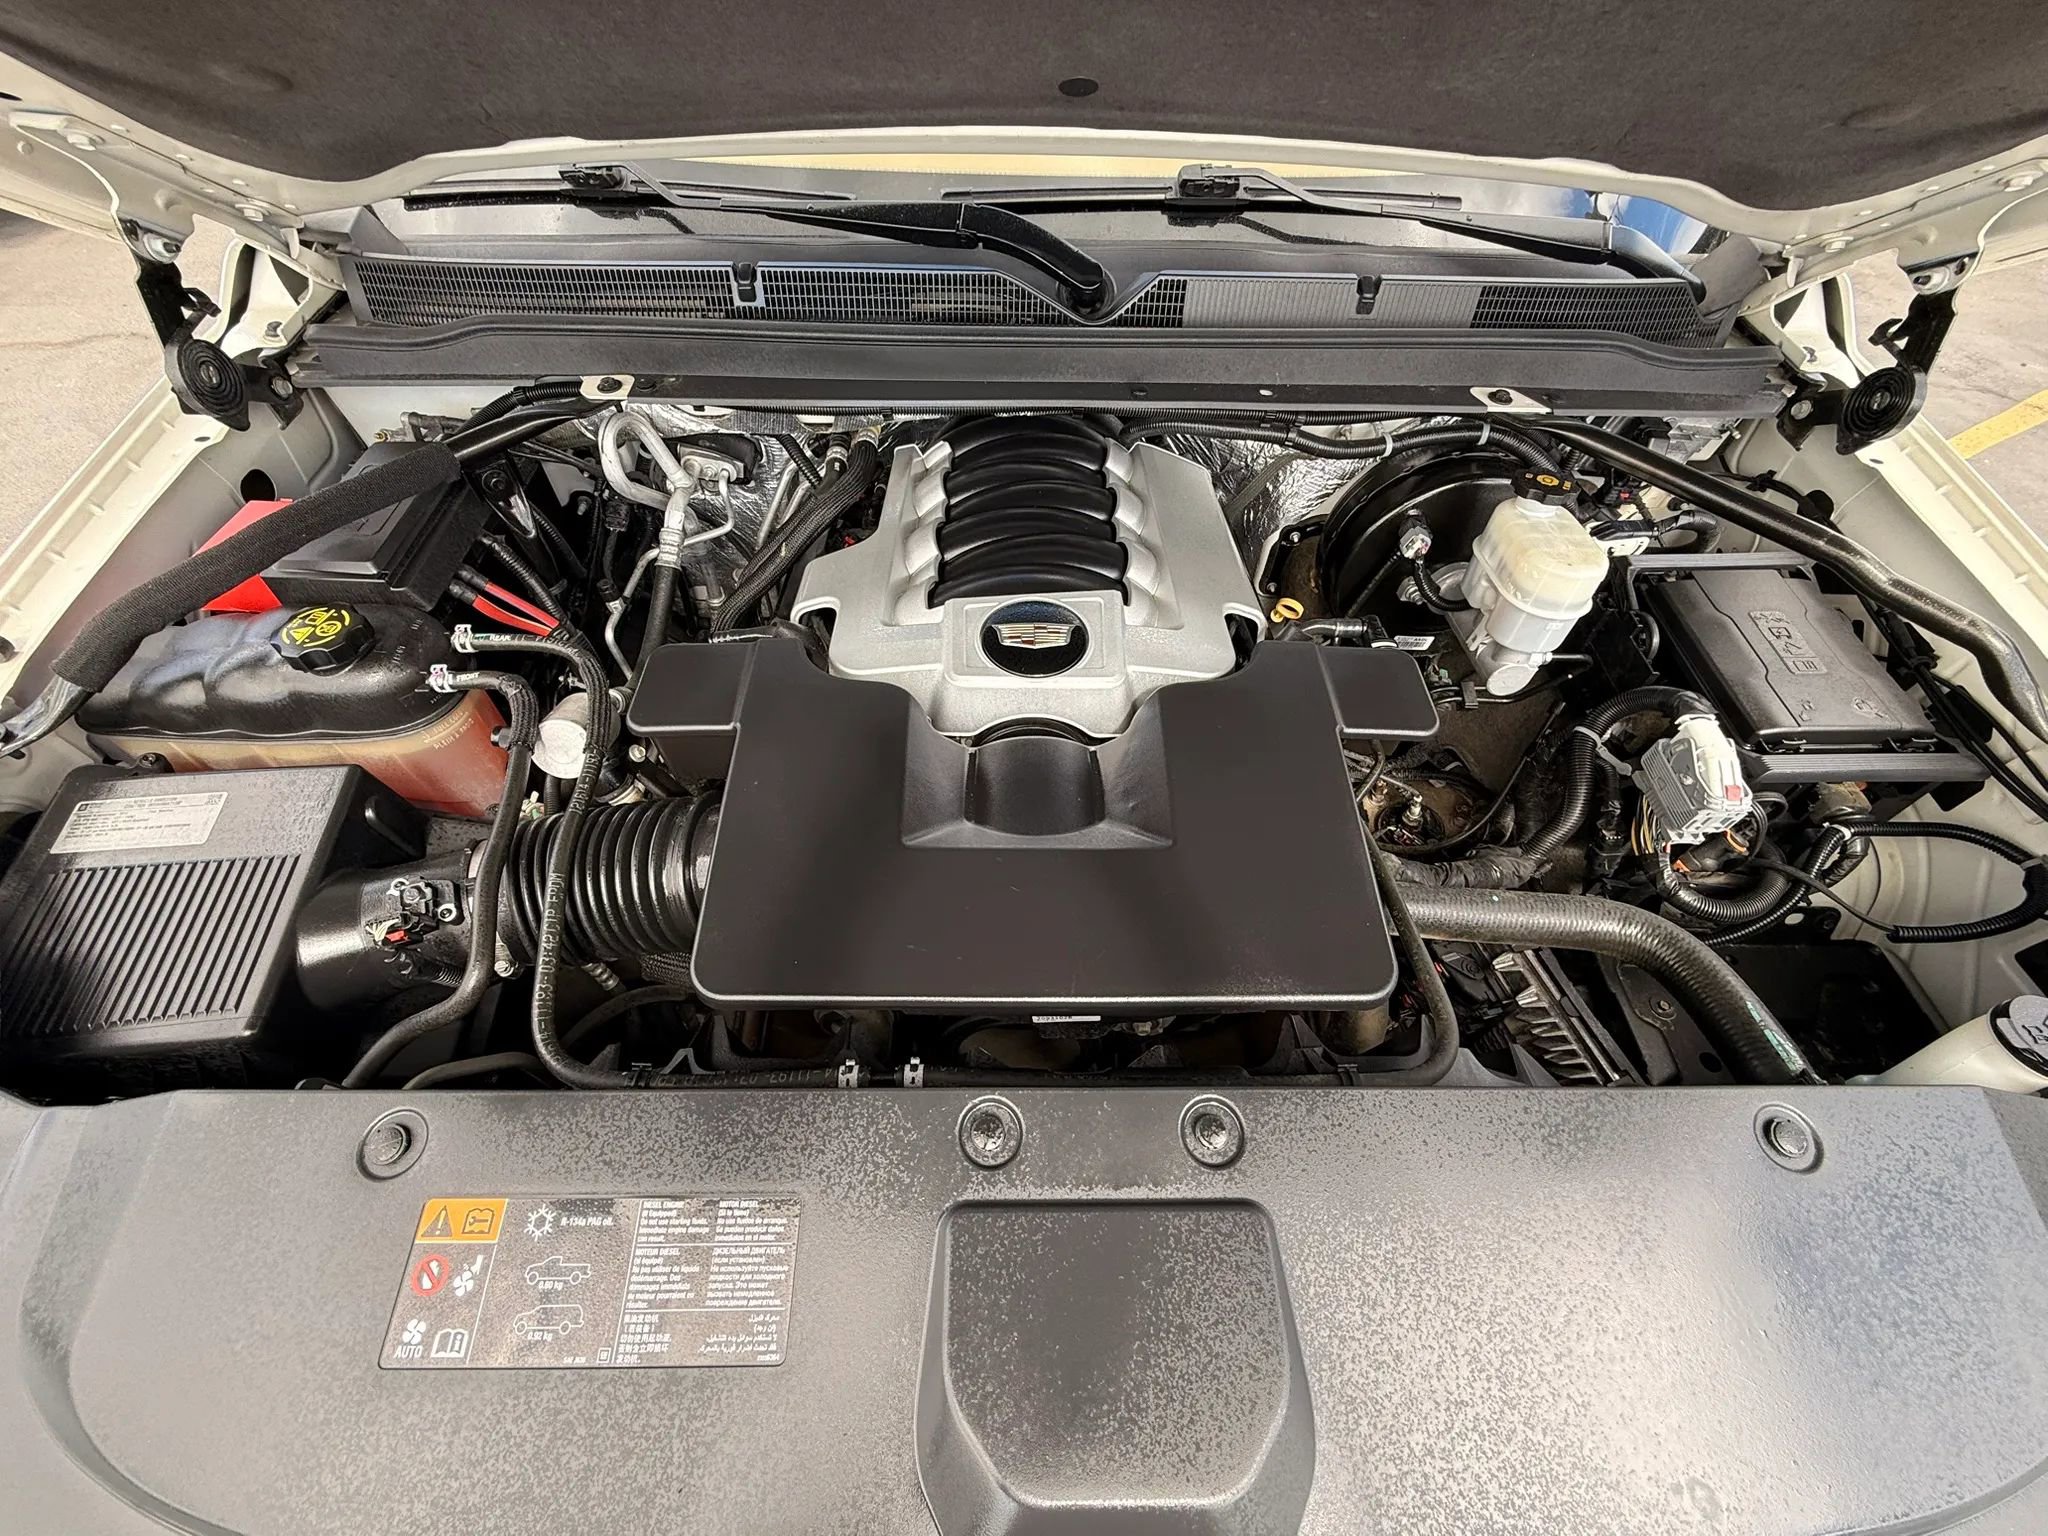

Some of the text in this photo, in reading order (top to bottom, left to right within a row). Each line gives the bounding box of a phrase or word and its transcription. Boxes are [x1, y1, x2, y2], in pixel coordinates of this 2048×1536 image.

[554, 1280, 564, 1291] kg
[543, 1331, 554, 1342] kg
[393, 1345, 423, 1359] AUTO
